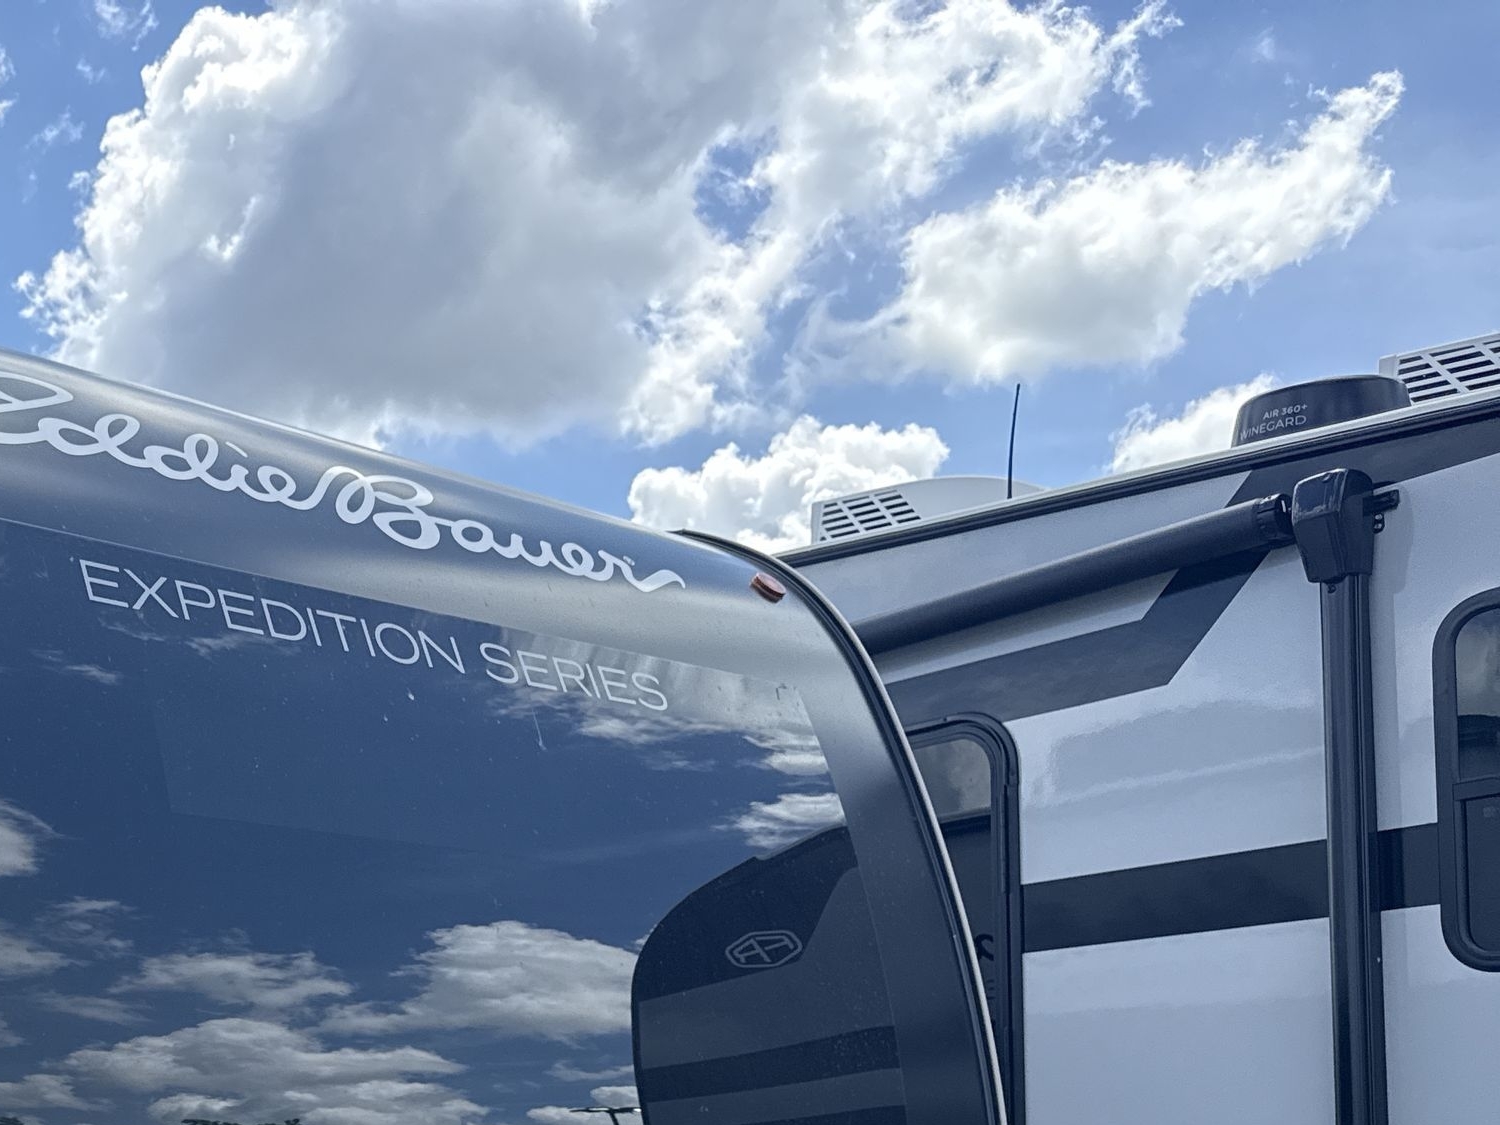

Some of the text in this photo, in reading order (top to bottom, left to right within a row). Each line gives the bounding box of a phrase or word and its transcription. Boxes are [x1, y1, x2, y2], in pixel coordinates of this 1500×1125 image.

[1240, 415, 1307, 440] WINEGARD
[1262, 403, 1308, 420] AIR 360+
[298, 465, 686, 593] Bauer
[79, 558, 669, 712] EXPEDITION SERIES
